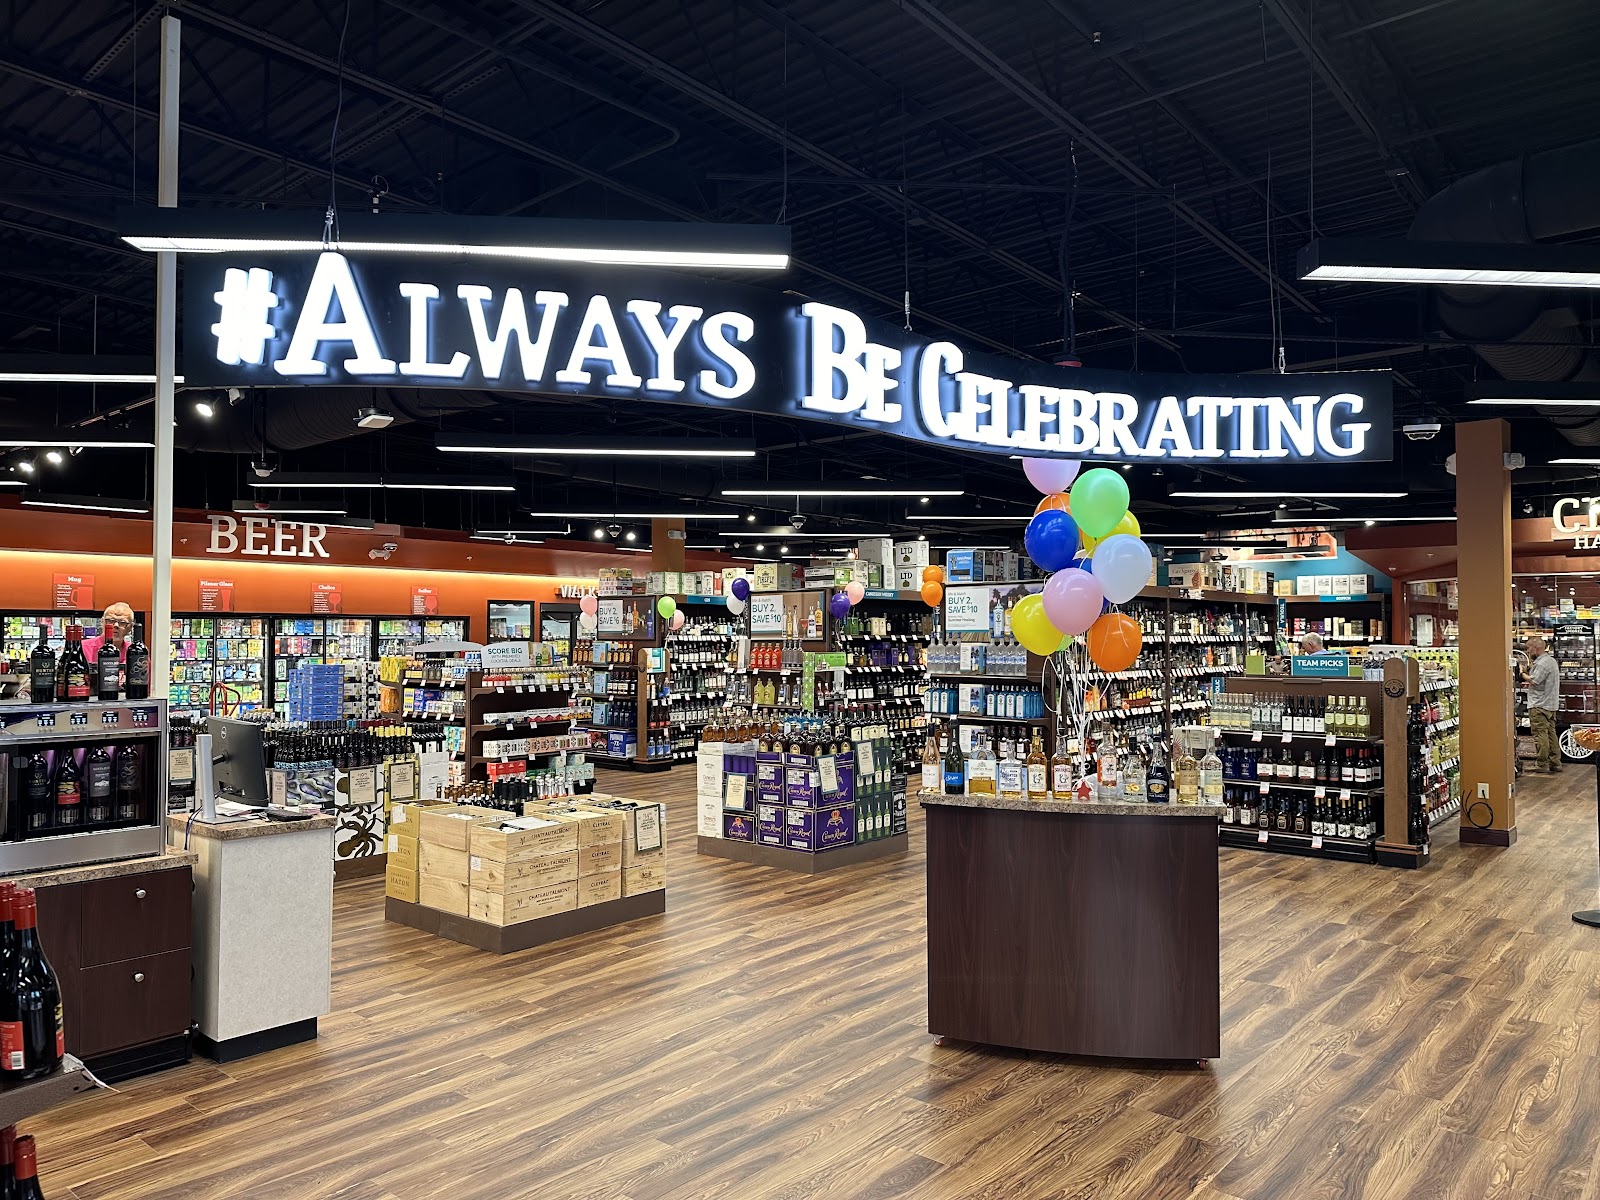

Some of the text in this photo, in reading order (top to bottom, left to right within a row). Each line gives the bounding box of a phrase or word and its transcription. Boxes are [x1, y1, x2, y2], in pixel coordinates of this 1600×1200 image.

[211, 252, 1372, 457] #ALWAYS BE CELEBRATING
[206, 514, 330, 558] BEER
[900, 546, 913, 555] LTD
[67, 576, 82, 584] Mug
[900, 572, 913, 580] LTD
[948, 597, 965, 605] BUY
[752, 604, 769, 613] BUY
[948, 605, 978, 614] SAVE $10
[599, 617, 613, 625] SAVE
[752, 614, 782, 624] SAVE $10
[1296, 659, 1344, 667] TEAM PICKS
[758, 781, 782, 791] Crown Royal
[787, 786, 812, 796] Crown Royal
[759, 822, 783, 832] Crown Royal
[787, 826, 812, 837] Crown Royal
[729, 828, 749, 837] Crown Royal
[821, 827, 849, 843] Crown Royal
